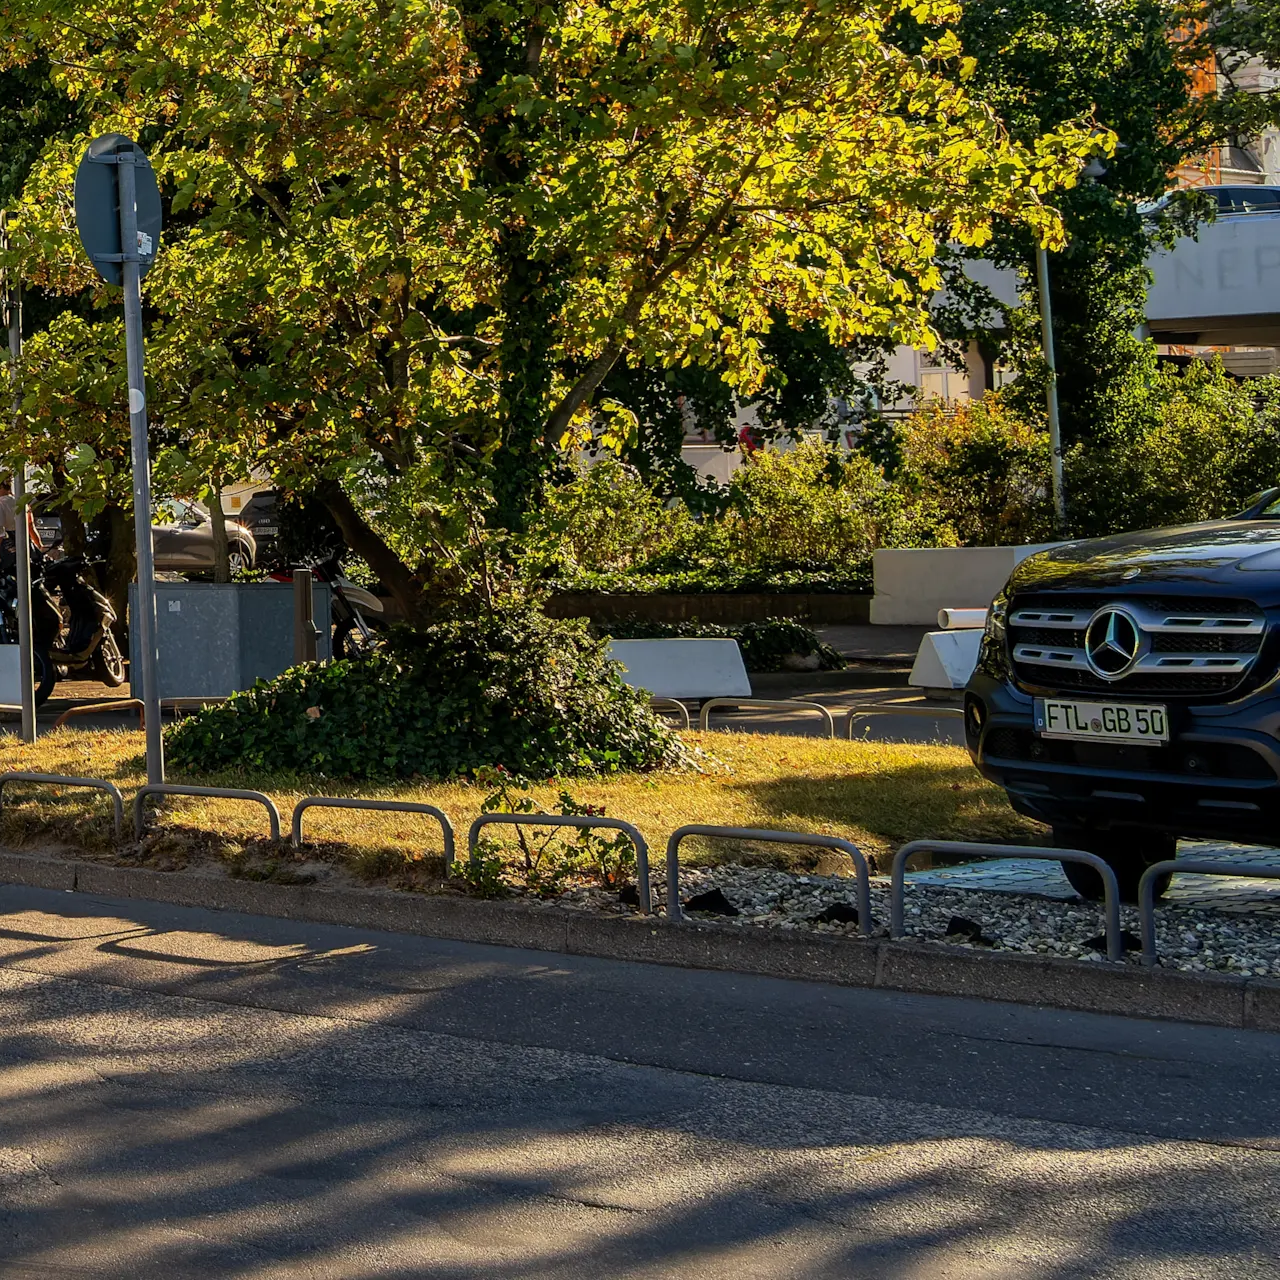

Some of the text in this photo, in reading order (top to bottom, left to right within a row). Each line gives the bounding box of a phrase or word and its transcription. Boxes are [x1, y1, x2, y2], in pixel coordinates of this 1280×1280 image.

[1047, 704, 1165, 735] FTL GB 50
